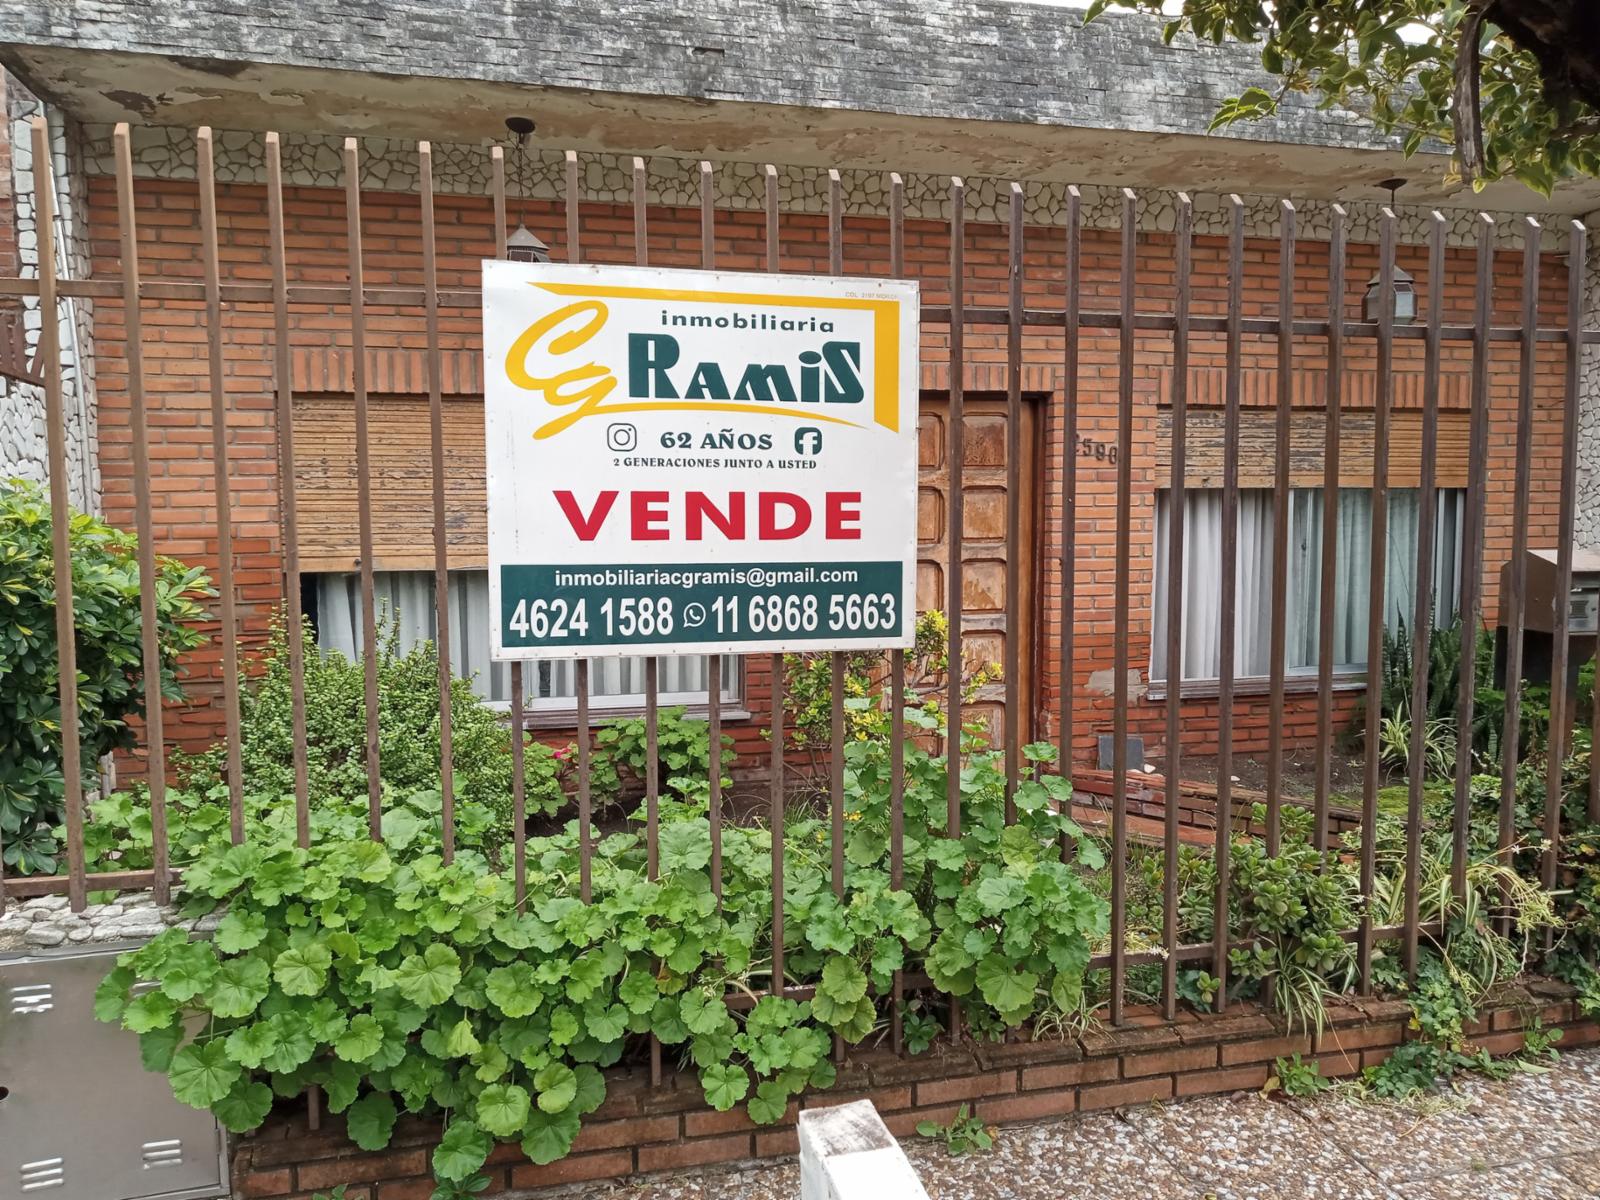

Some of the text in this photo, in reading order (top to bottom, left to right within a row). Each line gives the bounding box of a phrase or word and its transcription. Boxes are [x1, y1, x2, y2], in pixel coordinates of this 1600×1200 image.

[662, 309, 835, 333] inmobiliaria
[660, 428, 773, 450] 62 AÑOS
[613, 457, 817, 470] 2 GENERACIONES JUNTO A USTED
[553, 489, 862, 542] VENDE
[555, 567, 858, 589] inmobiliariacgramis@gmail.com
[509, 592, 897, 639] 4624 1588 11 6868 5663
